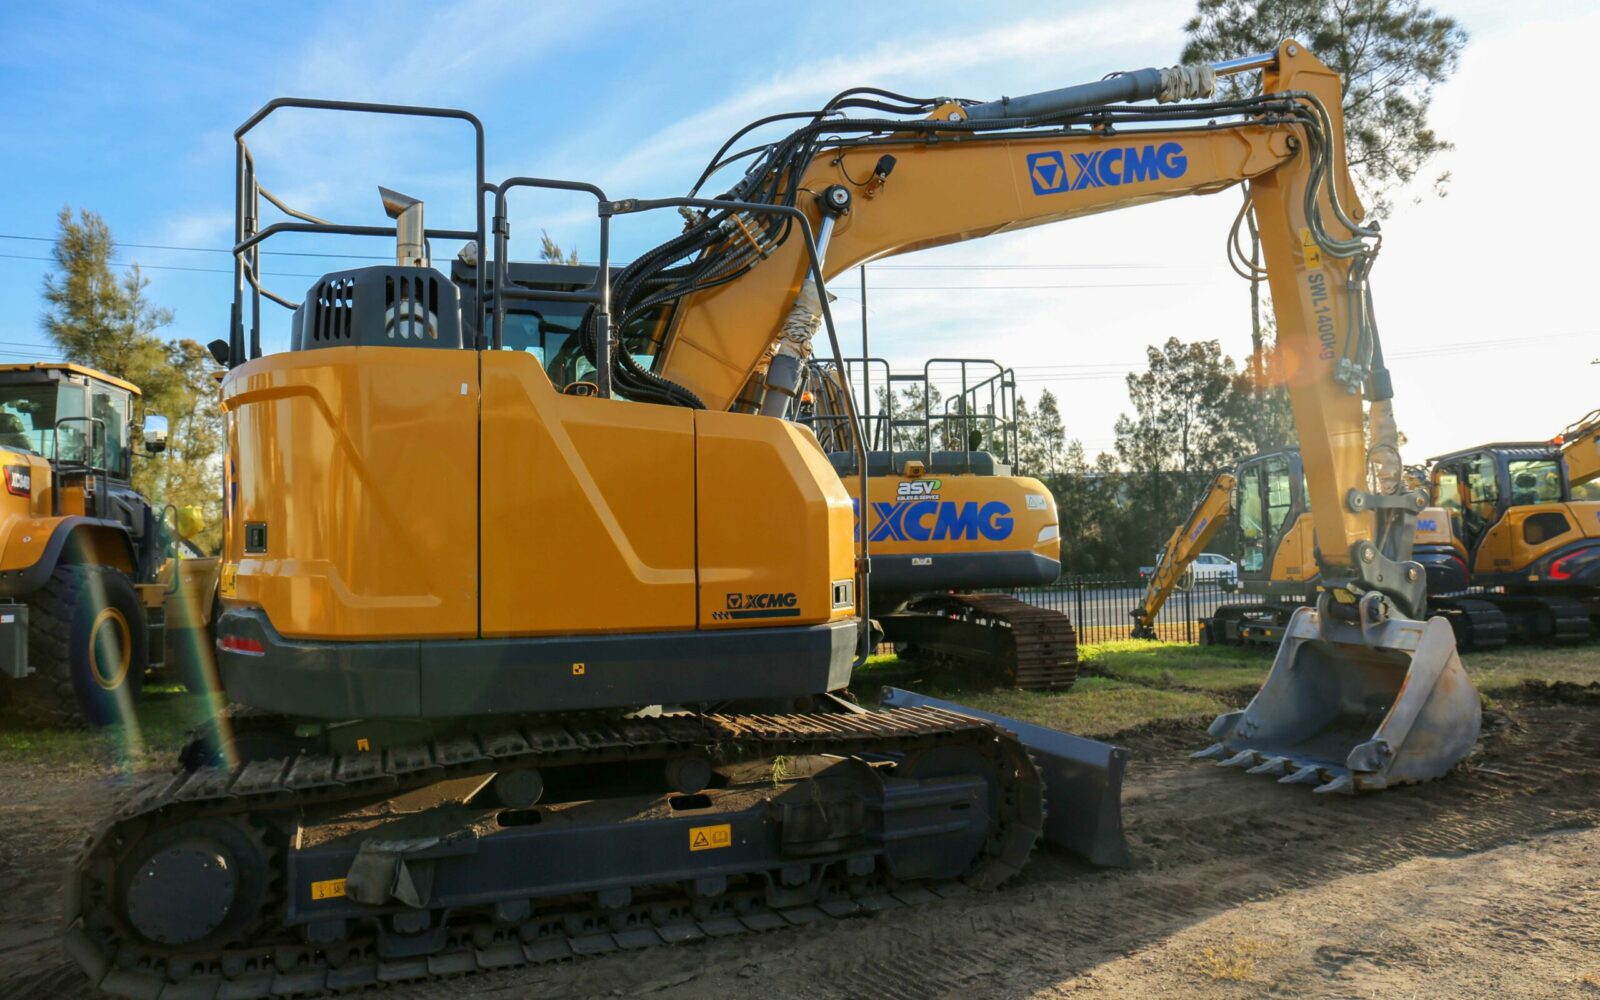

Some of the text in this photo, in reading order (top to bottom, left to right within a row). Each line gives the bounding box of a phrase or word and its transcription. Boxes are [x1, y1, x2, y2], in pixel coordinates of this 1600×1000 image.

[1070, 142, 1188, 191] XCMG
[868, 501, 1014, 542] XCMG
[744, 592, 798, 609] XCMG
